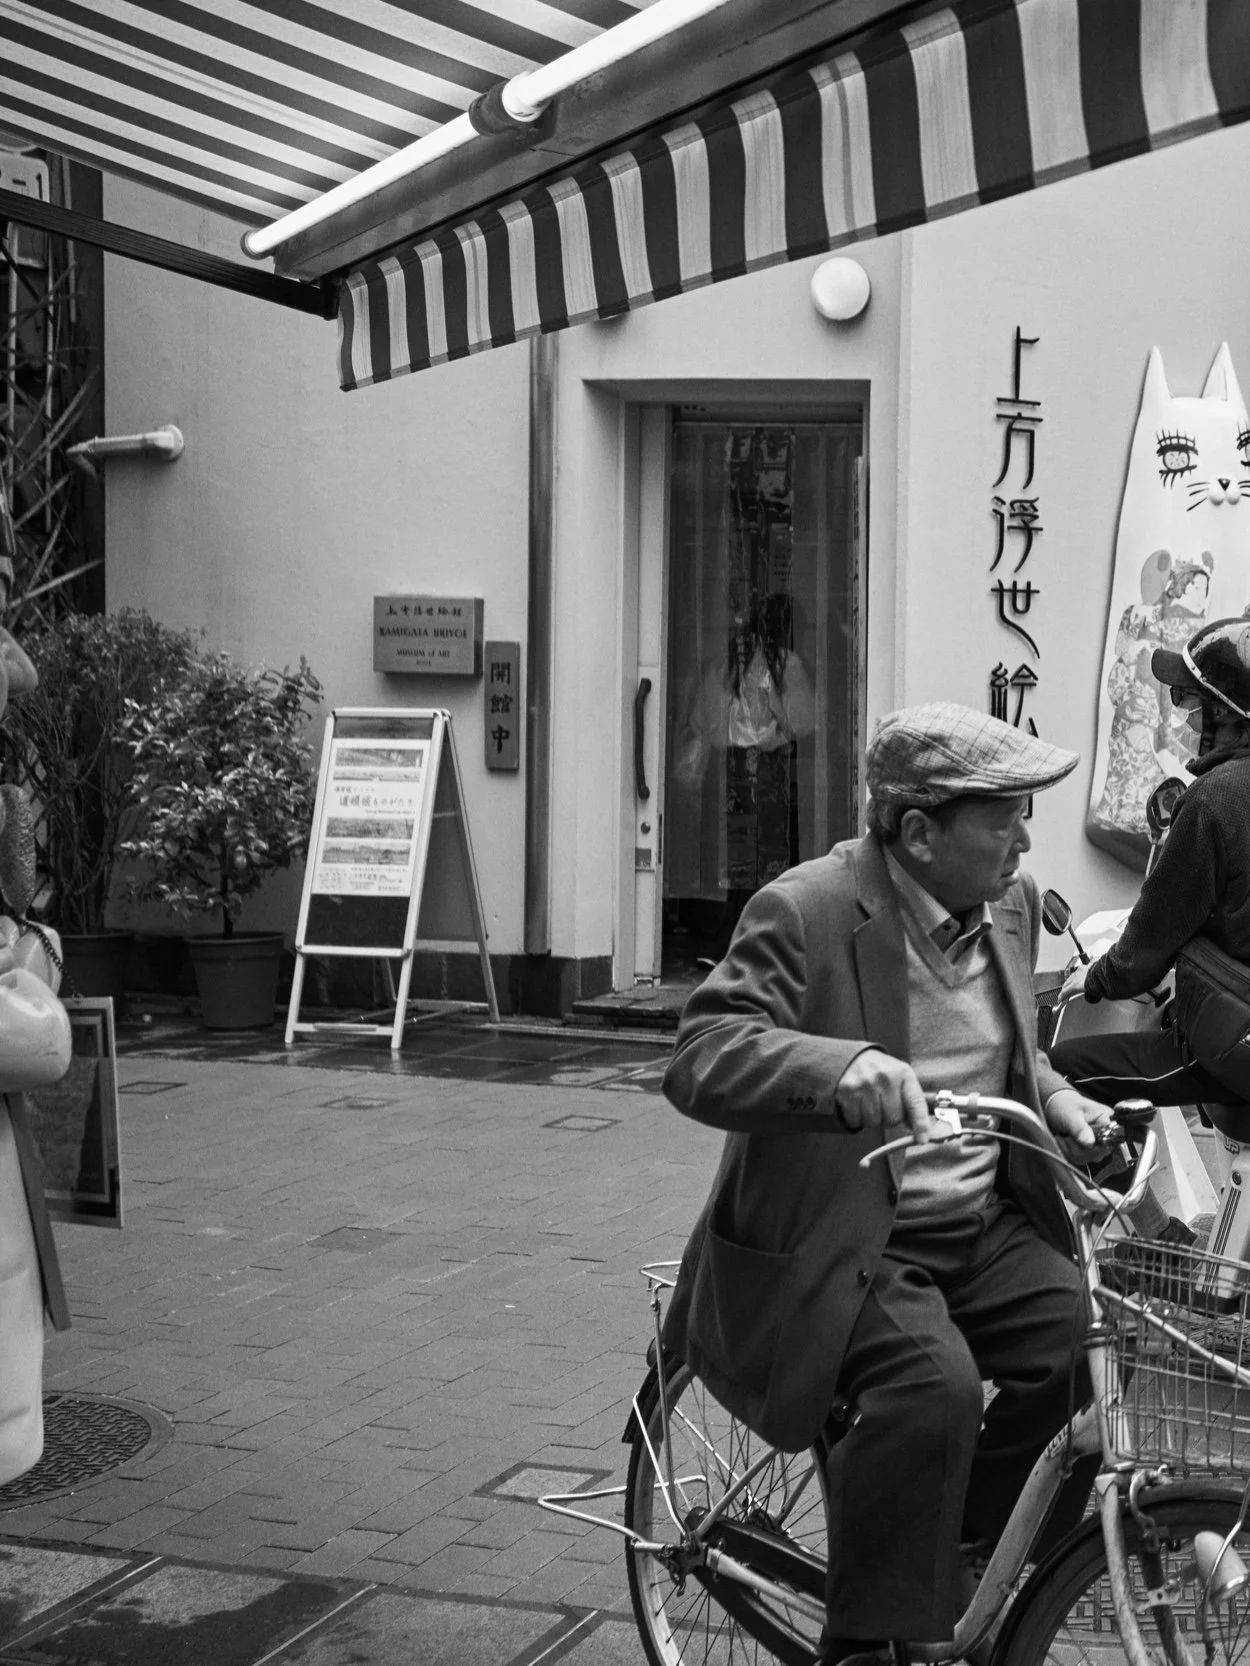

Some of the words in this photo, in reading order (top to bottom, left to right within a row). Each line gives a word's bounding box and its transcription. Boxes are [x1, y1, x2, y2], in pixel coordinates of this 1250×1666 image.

[490, 662, 513, 754] 開館中
[989, 324, 1043, 820] 上方浮世絵
